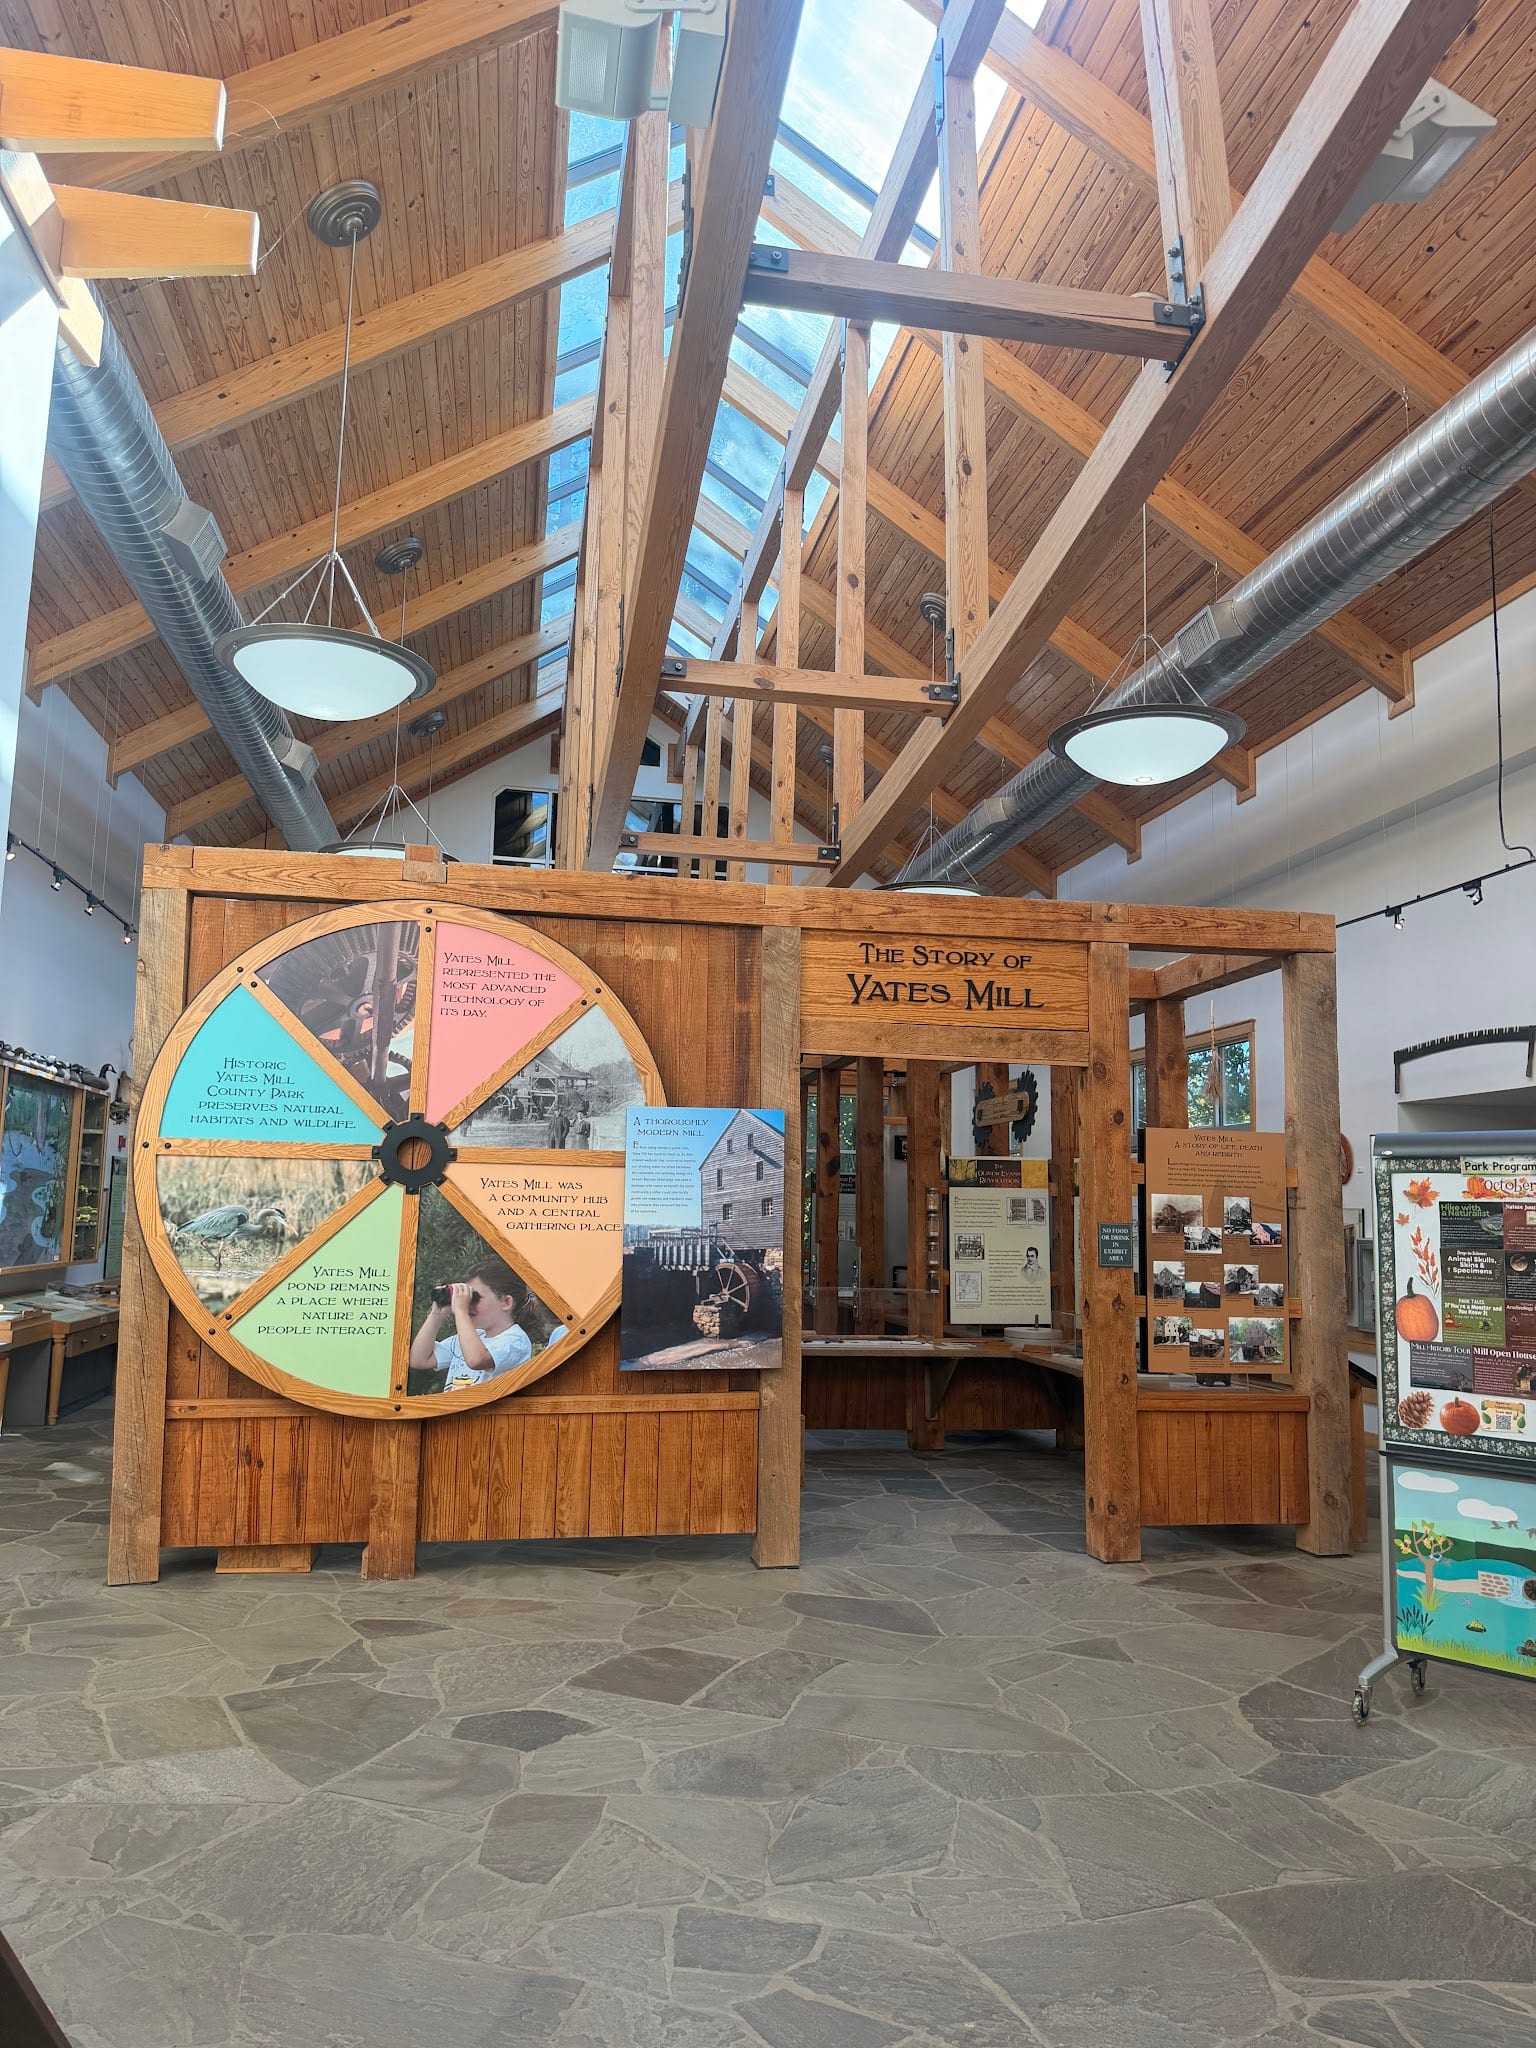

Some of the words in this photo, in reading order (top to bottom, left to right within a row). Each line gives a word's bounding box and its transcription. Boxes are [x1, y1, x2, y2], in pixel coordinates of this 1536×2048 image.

[444, 952, 482, 964] YATES
[486, 955, 516, 967] MILL
[858, 942, 905, 964] THE
[912, 945, 996, 967] STORY
[1003, 955, 1033, 969] OF
[442, 967, 530, 980] REPRESENTED
[533, 972, 557, 982] THE
[442, 981, 478, 991] MOST
[481, 983, 547, 994] ADVANCED
[846, 973, 951, 1005] YATES
[963, 979, 1045, 1011] MILL
[441, 994, 525, 1006] TECHNOLOGY
[528, 999, 545, 1007] OF
[462, 1009, 488, 1018] DAY.
[223, 1057, 287, 1071] HISTORIC
[216, 1071, 258, 1083] YATES
[263, 1073, 296, 1086] MILL
[207, 1085, 267, 1097] COUNTY
[271, 1087, 305, 1099] PARK
[199, 1101, 278, 1112] PRESERVES
[283, 1104, 344, 1115] NATURAL
[190, 1114, 255, 1125] HABITATS
[259, 1117, 288, 1127] AND
[293, 1118, 357, 1129] WILDLIFE.
[633, 1116, 641, 1126] A
[644, 1118, 709, 1126] THOROUGHLY
[637, 1129, 679, 1137] MODERN
[682, 1129, 705, 1137] MILL
[1464, 1161, 1489, 1171] Park
[480, 1177, 519, 1190] YATES
[523, 1178, 553, 1190] MILL
[558, 1181, 583, 1190] WAS
[488, 1193, 498, 1202] A
[502, 1194, 579, 1204] COMMUNITY
[583, 1195, 609, 1204] HUB
[497, 1207, 525, 1216] AND
[529, 1208, 538, 1216] A
[542, 1208, 601, 1218] CENTRAL
[1447, 1209, 1490, 1217] Naturalist
[506, 1221, 576, 1231] GATHERING
[580, 1222, 623, 1232] PLACE.
[1474, 1256, 1497, 1264] Skulls,
[313, 1266, 354, 1278] YATES
[359, 1266, 391, 1279] MILL
[1452, 1267, 1493, 1275] Specimens
[287, 1282, 326, 1291] POND
[330, 1283, 390, 1292] REMAINS
[276, 1296, 286, 1305] A
[291, 1297, 337, 1306] PLACE
[342, 1297, 389, 1306] WHERE
[302, 1311, 355, 1320] NATURE
[359, 1312, 388, 1321] AND
[257, 1325, 312, 1335] PEOPLE
[316, 1326, 387, 1335] INTERACT.
[1473, 1347, 1488, 1356] Mill
[1489, 1349, 1511, 1358] Open
[1512, 1351, 1536, 1360] House
